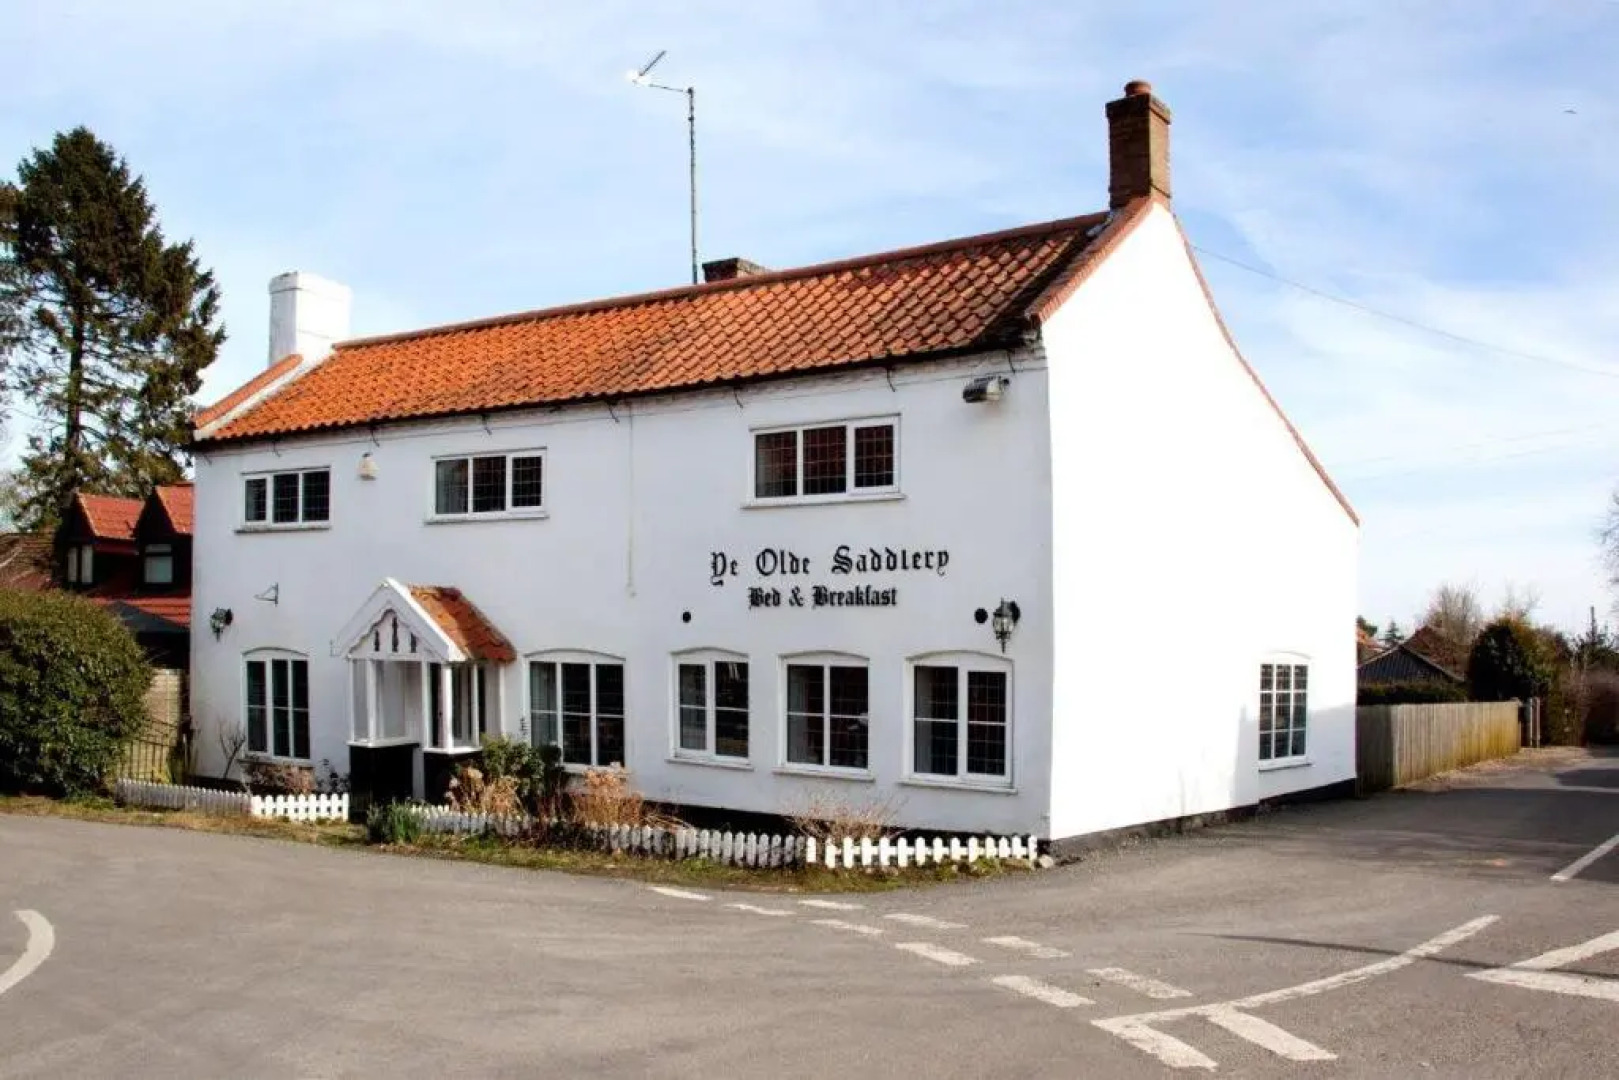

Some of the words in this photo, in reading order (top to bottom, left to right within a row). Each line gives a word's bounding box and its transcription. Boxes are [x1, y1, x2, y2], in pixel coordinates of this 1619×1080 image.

[710, 551, 738, 587] Ye
[756, 547, 811, 577] Olde
[831, 544, 950, 576] Saddlery
[748, 585, 782, 610] Bed
[788, 585, 804, 608] &
[812, 584, 898, 609] Breakfast
